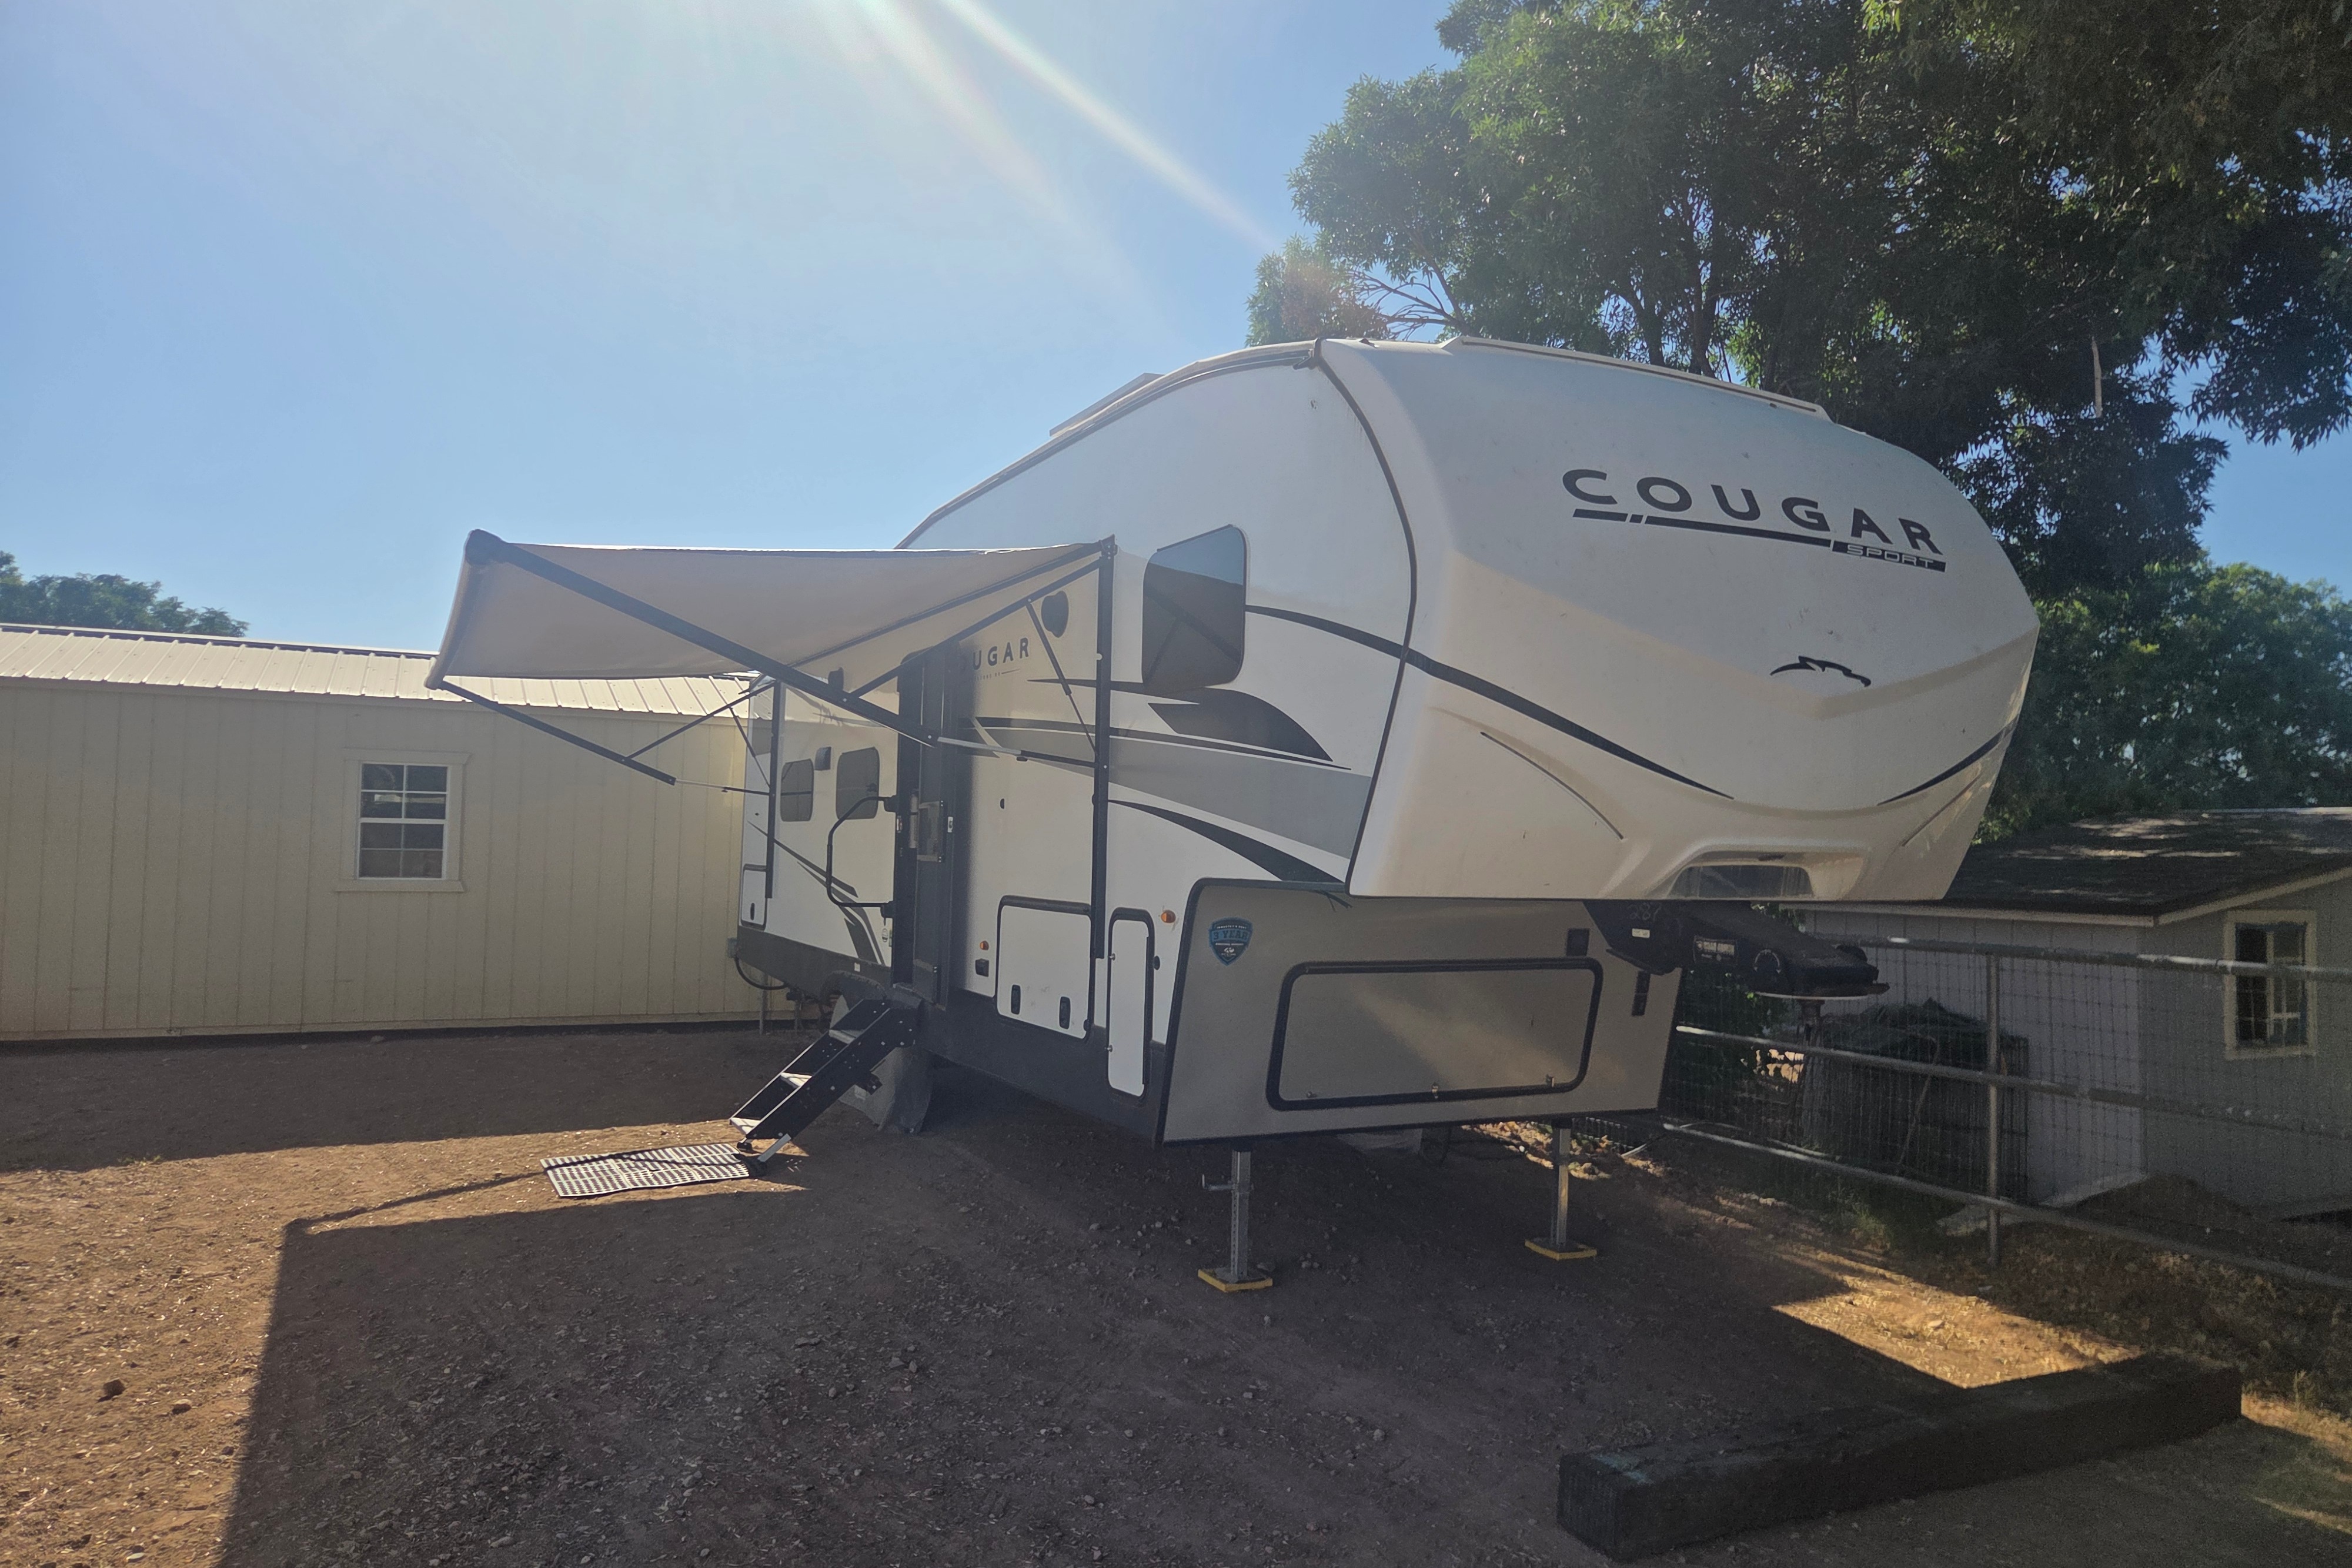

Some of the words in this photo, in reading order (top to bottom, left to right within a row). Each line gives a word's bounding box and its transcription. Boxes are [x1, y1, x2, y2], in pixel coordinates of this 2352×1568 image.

[1562, 469, 1943, 555] COUGAR
[1846, 543, 1935, 568] SPORT
[973, 637, 1029, 670] UGAR
[1223, 930, 1248, 940] YEAR
